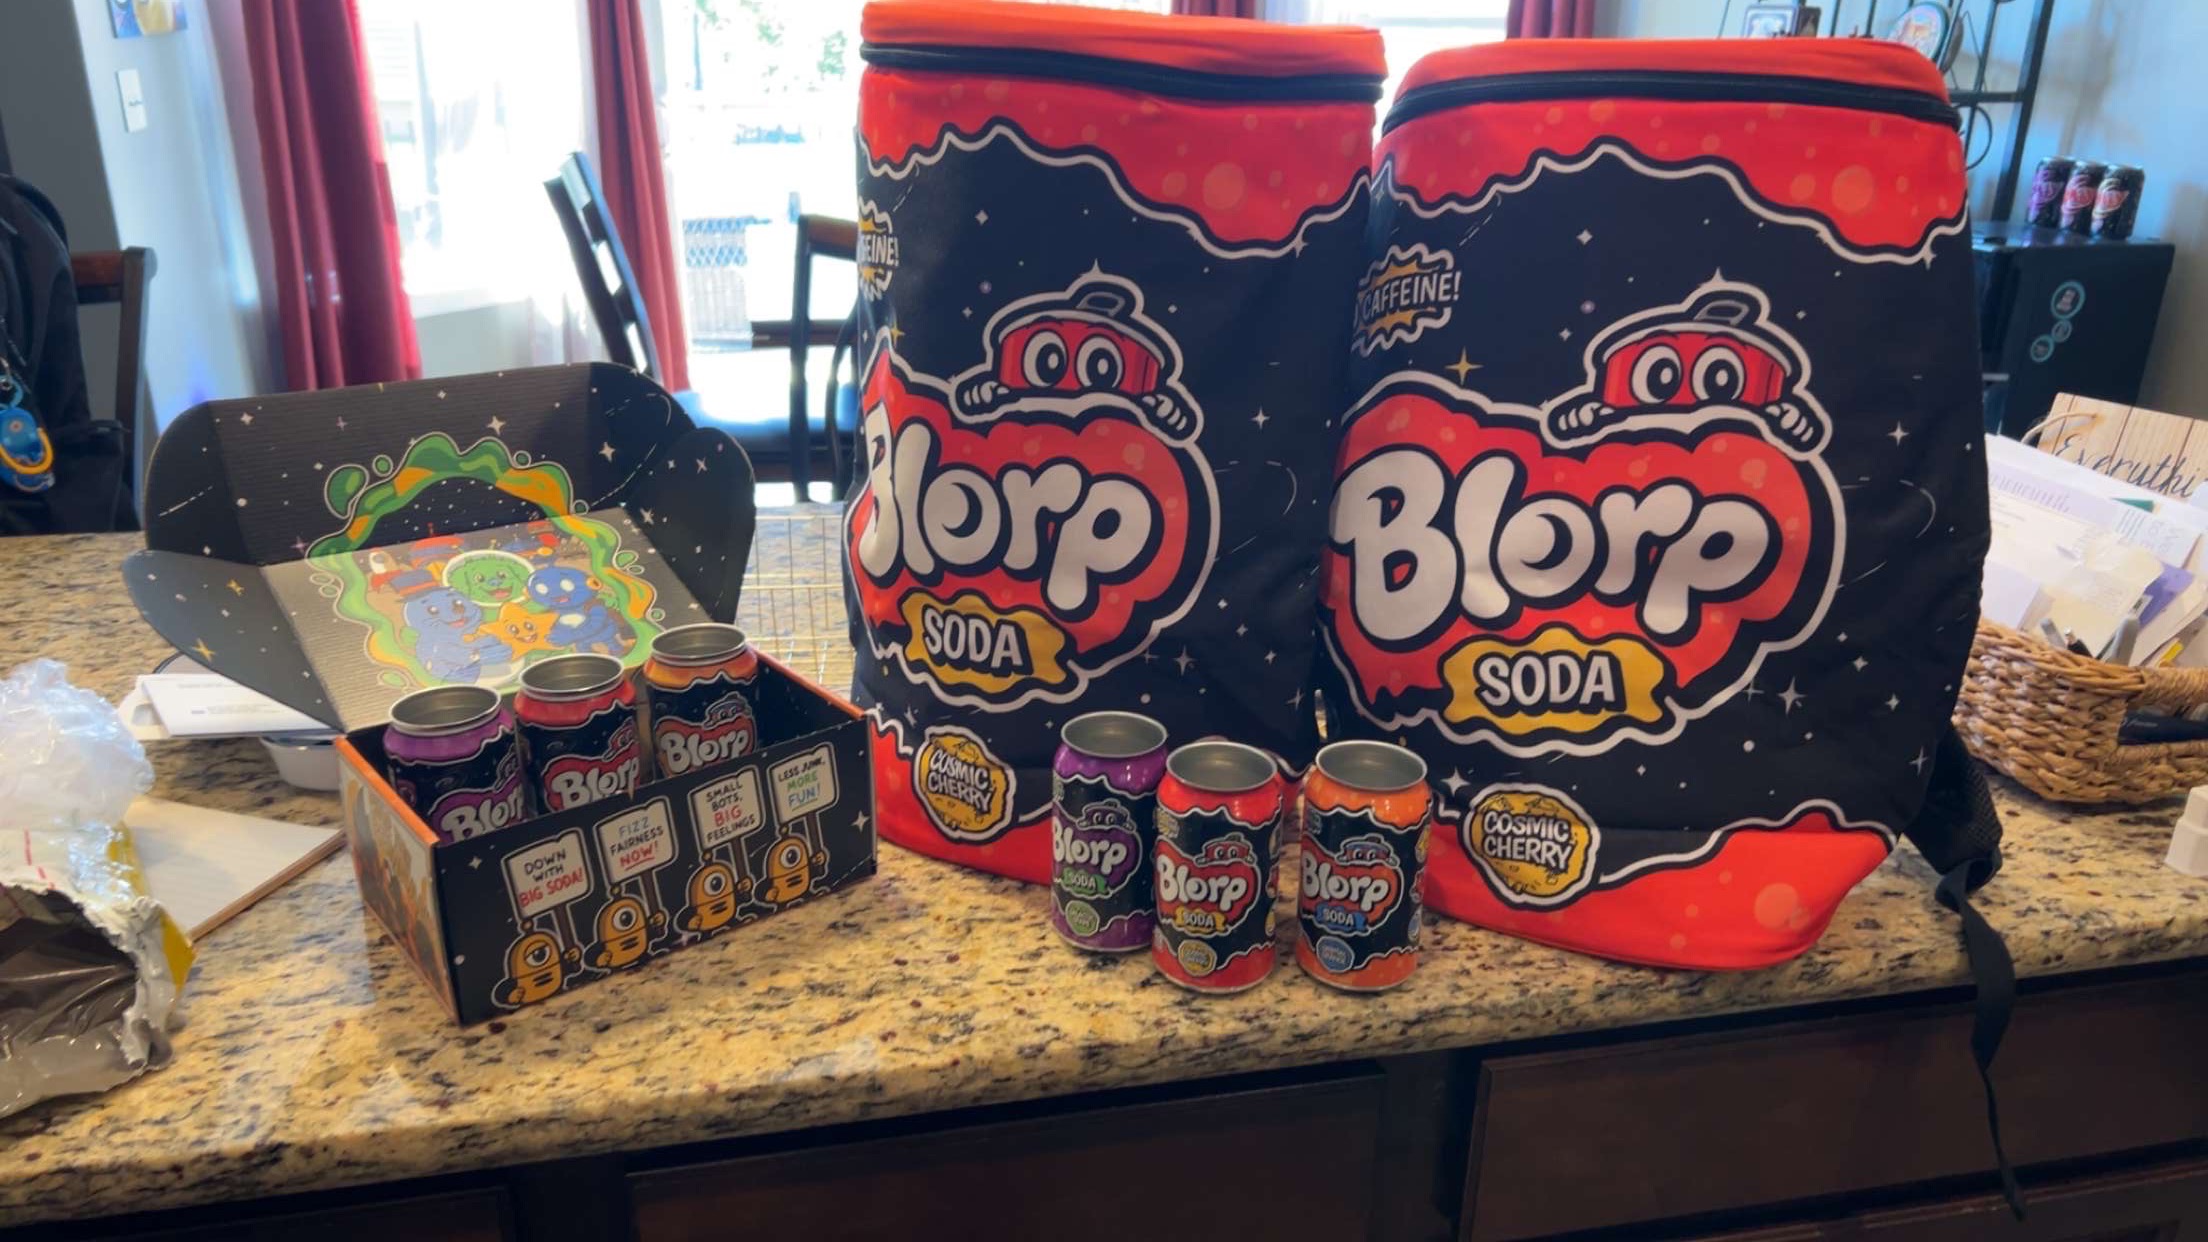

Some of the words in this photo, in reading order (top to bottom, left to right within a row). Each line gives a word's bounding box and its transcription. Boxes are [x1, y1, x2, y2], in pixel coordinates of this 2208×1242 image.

[860, 233, 899, 267] EINE!
[1362, 270, 1462, 319] CAFFEINE!
[2055, 433, 2208, 499] Everythi
[859, 401, 1152, 611] Blorp
[1333, 449, 1770, 640] Blorp
[923, 607, 1024, 669] SODA
[1477, 655, 1616, 707] SODA
[660, 729, 748, 774] Blorp
[551, 757, 639, 810] Blorp
[778, 768, 800, 782] LESS
[787, 771, 818, 791] MORE
[930, 748, 989, 790] COSMIC
[706, 781, 743, 803] SMALL
[788, 783, 820, 808] FUN!
[928, 771, 991, 812] CHERRY
[619, 817, 649, 836] FIZZ
[706, 814, 755, 842] FEELINGS
[714, 807, 742, 827] BIG
[1484, 810, 1569, 843] COSMIC
[610, 825, 664, 856] FAIRNESS
[620, 840, 659, 867] NOW!
[1052, 816, 1128, 875] Blorp
[1483, 835, 1572, 869] CHERRY
[523, 848, 567, 875] DOWN
[532, 864, 565, 882] WITH
[519, 886, 544, 908] BIG
[545, 868, 583, 896] SODA!
[1069, 871, 1097, 889] SODA
[1156, 854, 1248, 912] Blorp
[1302, 851, 1389, 912] Blorp
[1182, 912, 1215, 928] SODA
[1322, 908, 1355, 927] SODA
